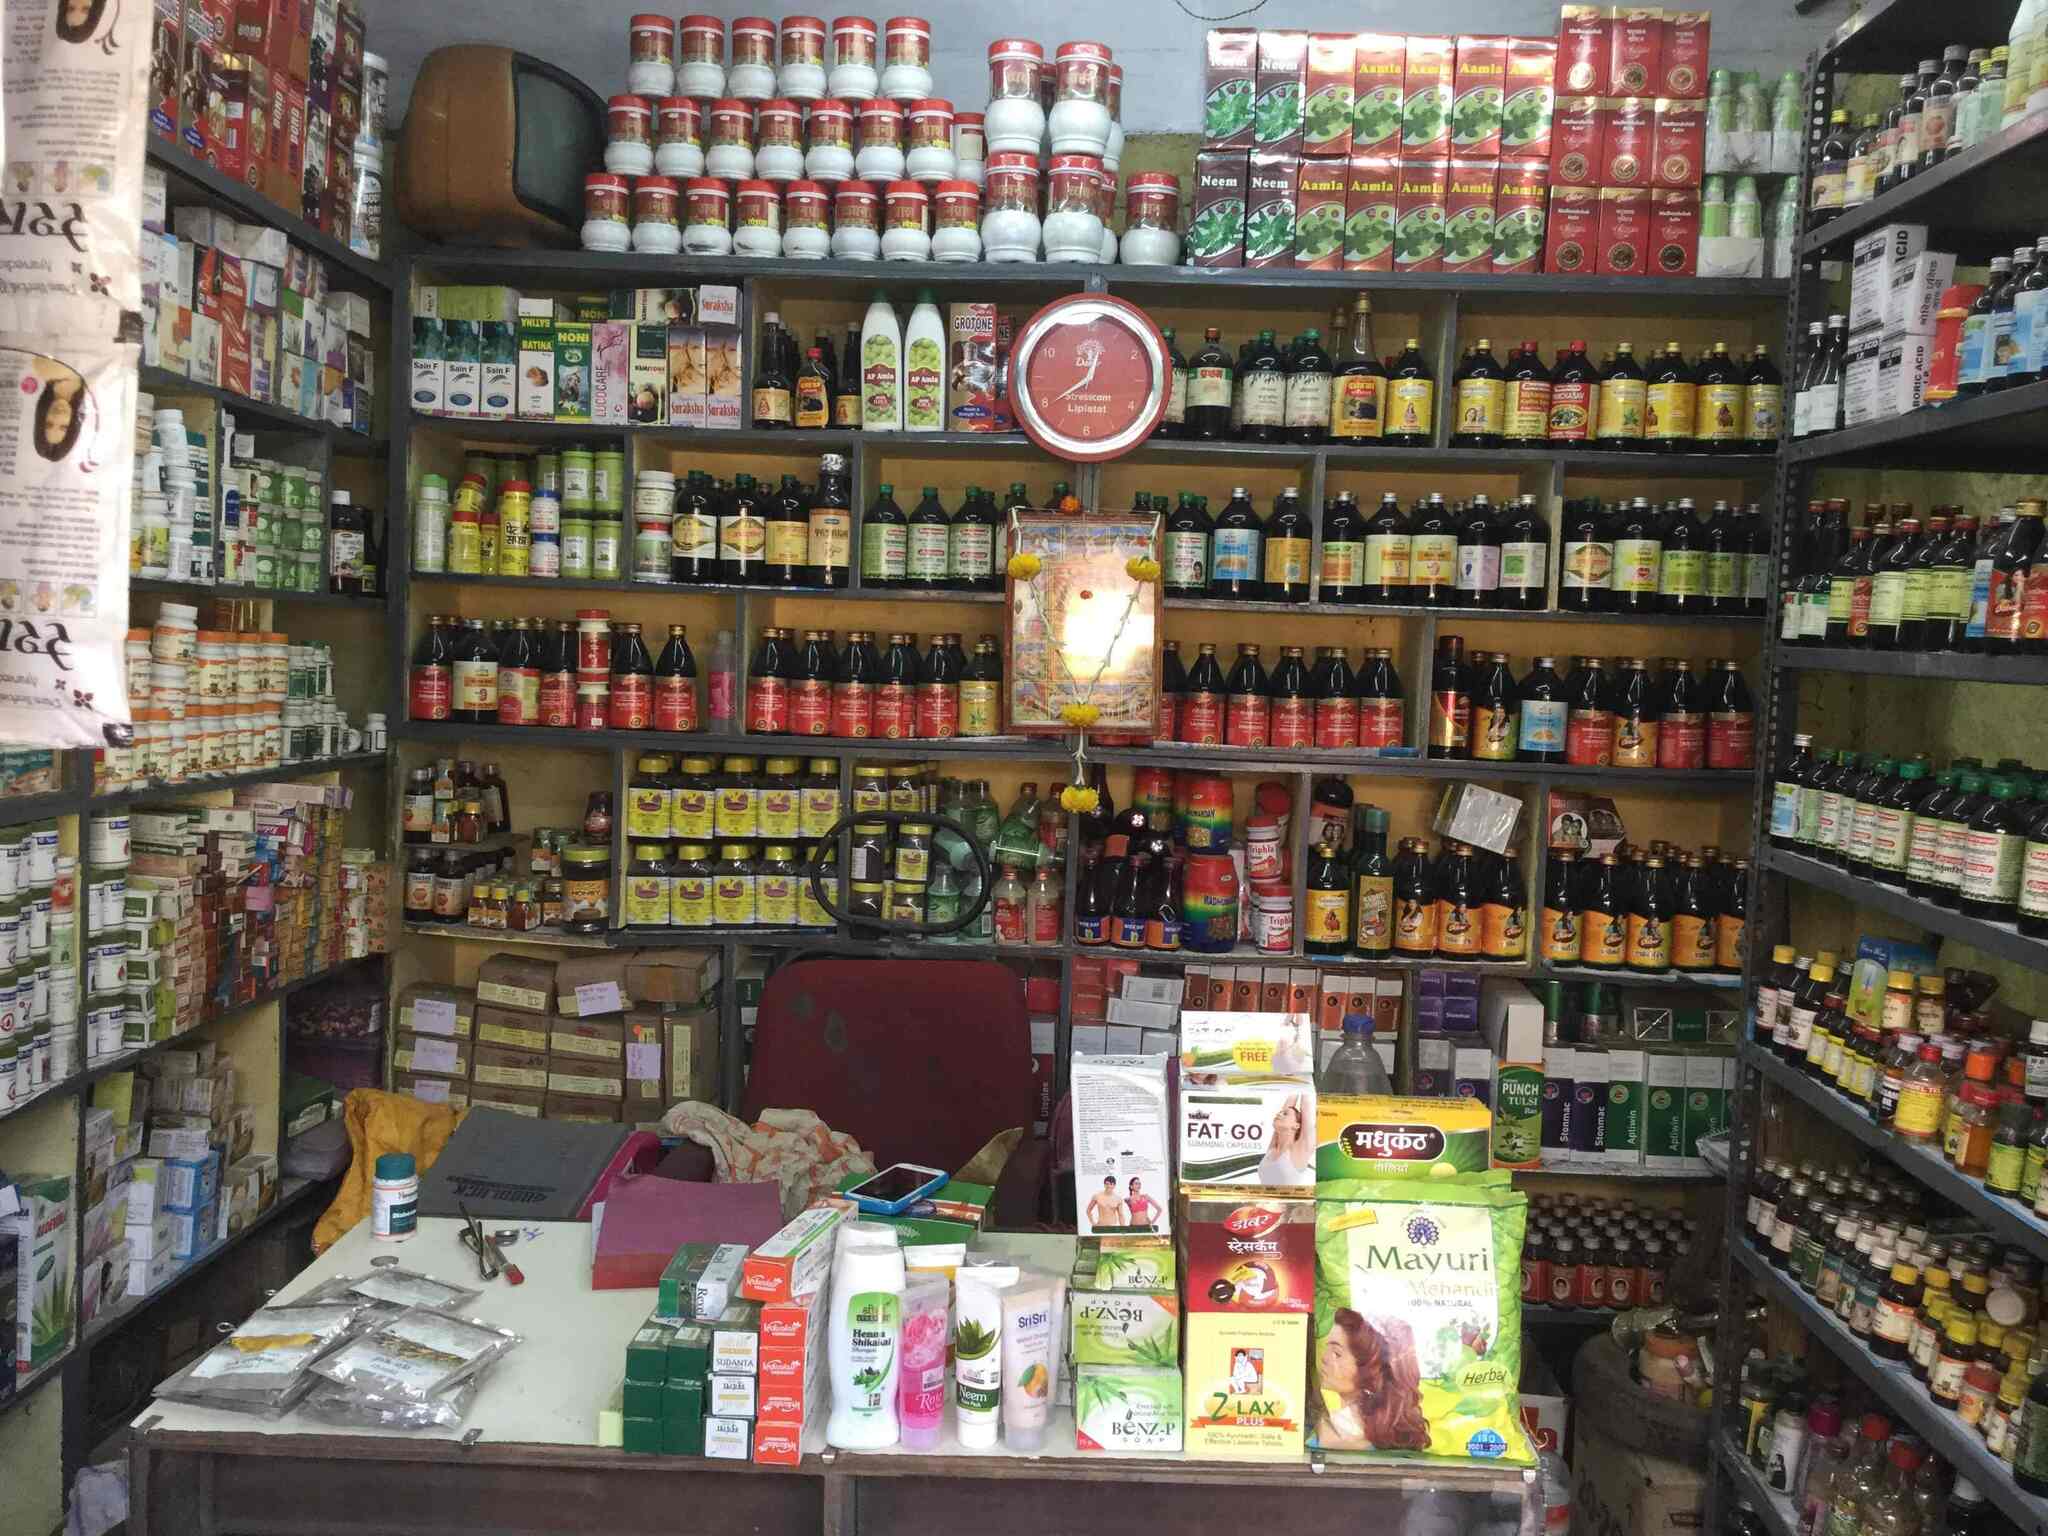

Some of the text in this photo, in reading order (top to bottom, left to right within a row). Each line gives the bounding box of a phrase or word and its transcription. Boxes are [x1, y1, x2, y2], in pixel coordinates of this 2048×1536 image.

[1261, 59, 1298, 70] Neem
[1359, 63, 1401, 74] Aamla
[1460, 63, 1504, 74] Aamla
[1200, 175, 1238, 187] Neem
[1252, 177, 1289, 189] Neem
[1301, 181, 1344, 191] Aamla
[1351, 181, 1394, 192] Aamla
[1402, 182, 1444, 193] Aamla
[1451, 182, 1494, 193] Aamla
[1502, 184, 1544, 195] Aamla
[703, 299, 733, 312] Suraksha
[954, 316, 992, 331] GROTONE
[558, 333, 589, 343] NONI
[1044, 347, 1055, 359] 10
[1131, 350, 1138, 360] 2
[414, 362, 432, 370] Sain
[449, 365, 467, 373] Sain
[877, 372, 895, 380] Amla
[921, 375, 938, 383] Amla
[1911, 346, 1924, 407] BORIC ACID
[671, 402, 704, 415] Suraksha
[1041, 398, 1049, 408] 8
[1128, 401, 1135, 411] 4
[708, 403, 740, 417] Suraksha
[1083, 425, 1090, 436] 6
[1240, 1051, 1268, 1062] FREE
[1502, 1082, 1539, 1096] PUNCH
[1508, 1096, 1538, 1106] TULSI
[1560, 1101, 1571, 1143] Stonmac
[1595, 1106, 1605, 1147] Stonmac
[1628, 1109, 1637, 1146] Aptiwin
[1226, 1141, 1262, 1149] CAPSULES
[1355, 1127, 1429, 1157] मधुकंठ
[1367, 1245, 1489, 1273] Mayuri
[852, 1329, 886, 1338] Henna
[1463, 1367, 1507, 1384] Herbal
[959, 1385, 987, 1402] Neem
[1237, 1400, 1275, 1415] LAX
